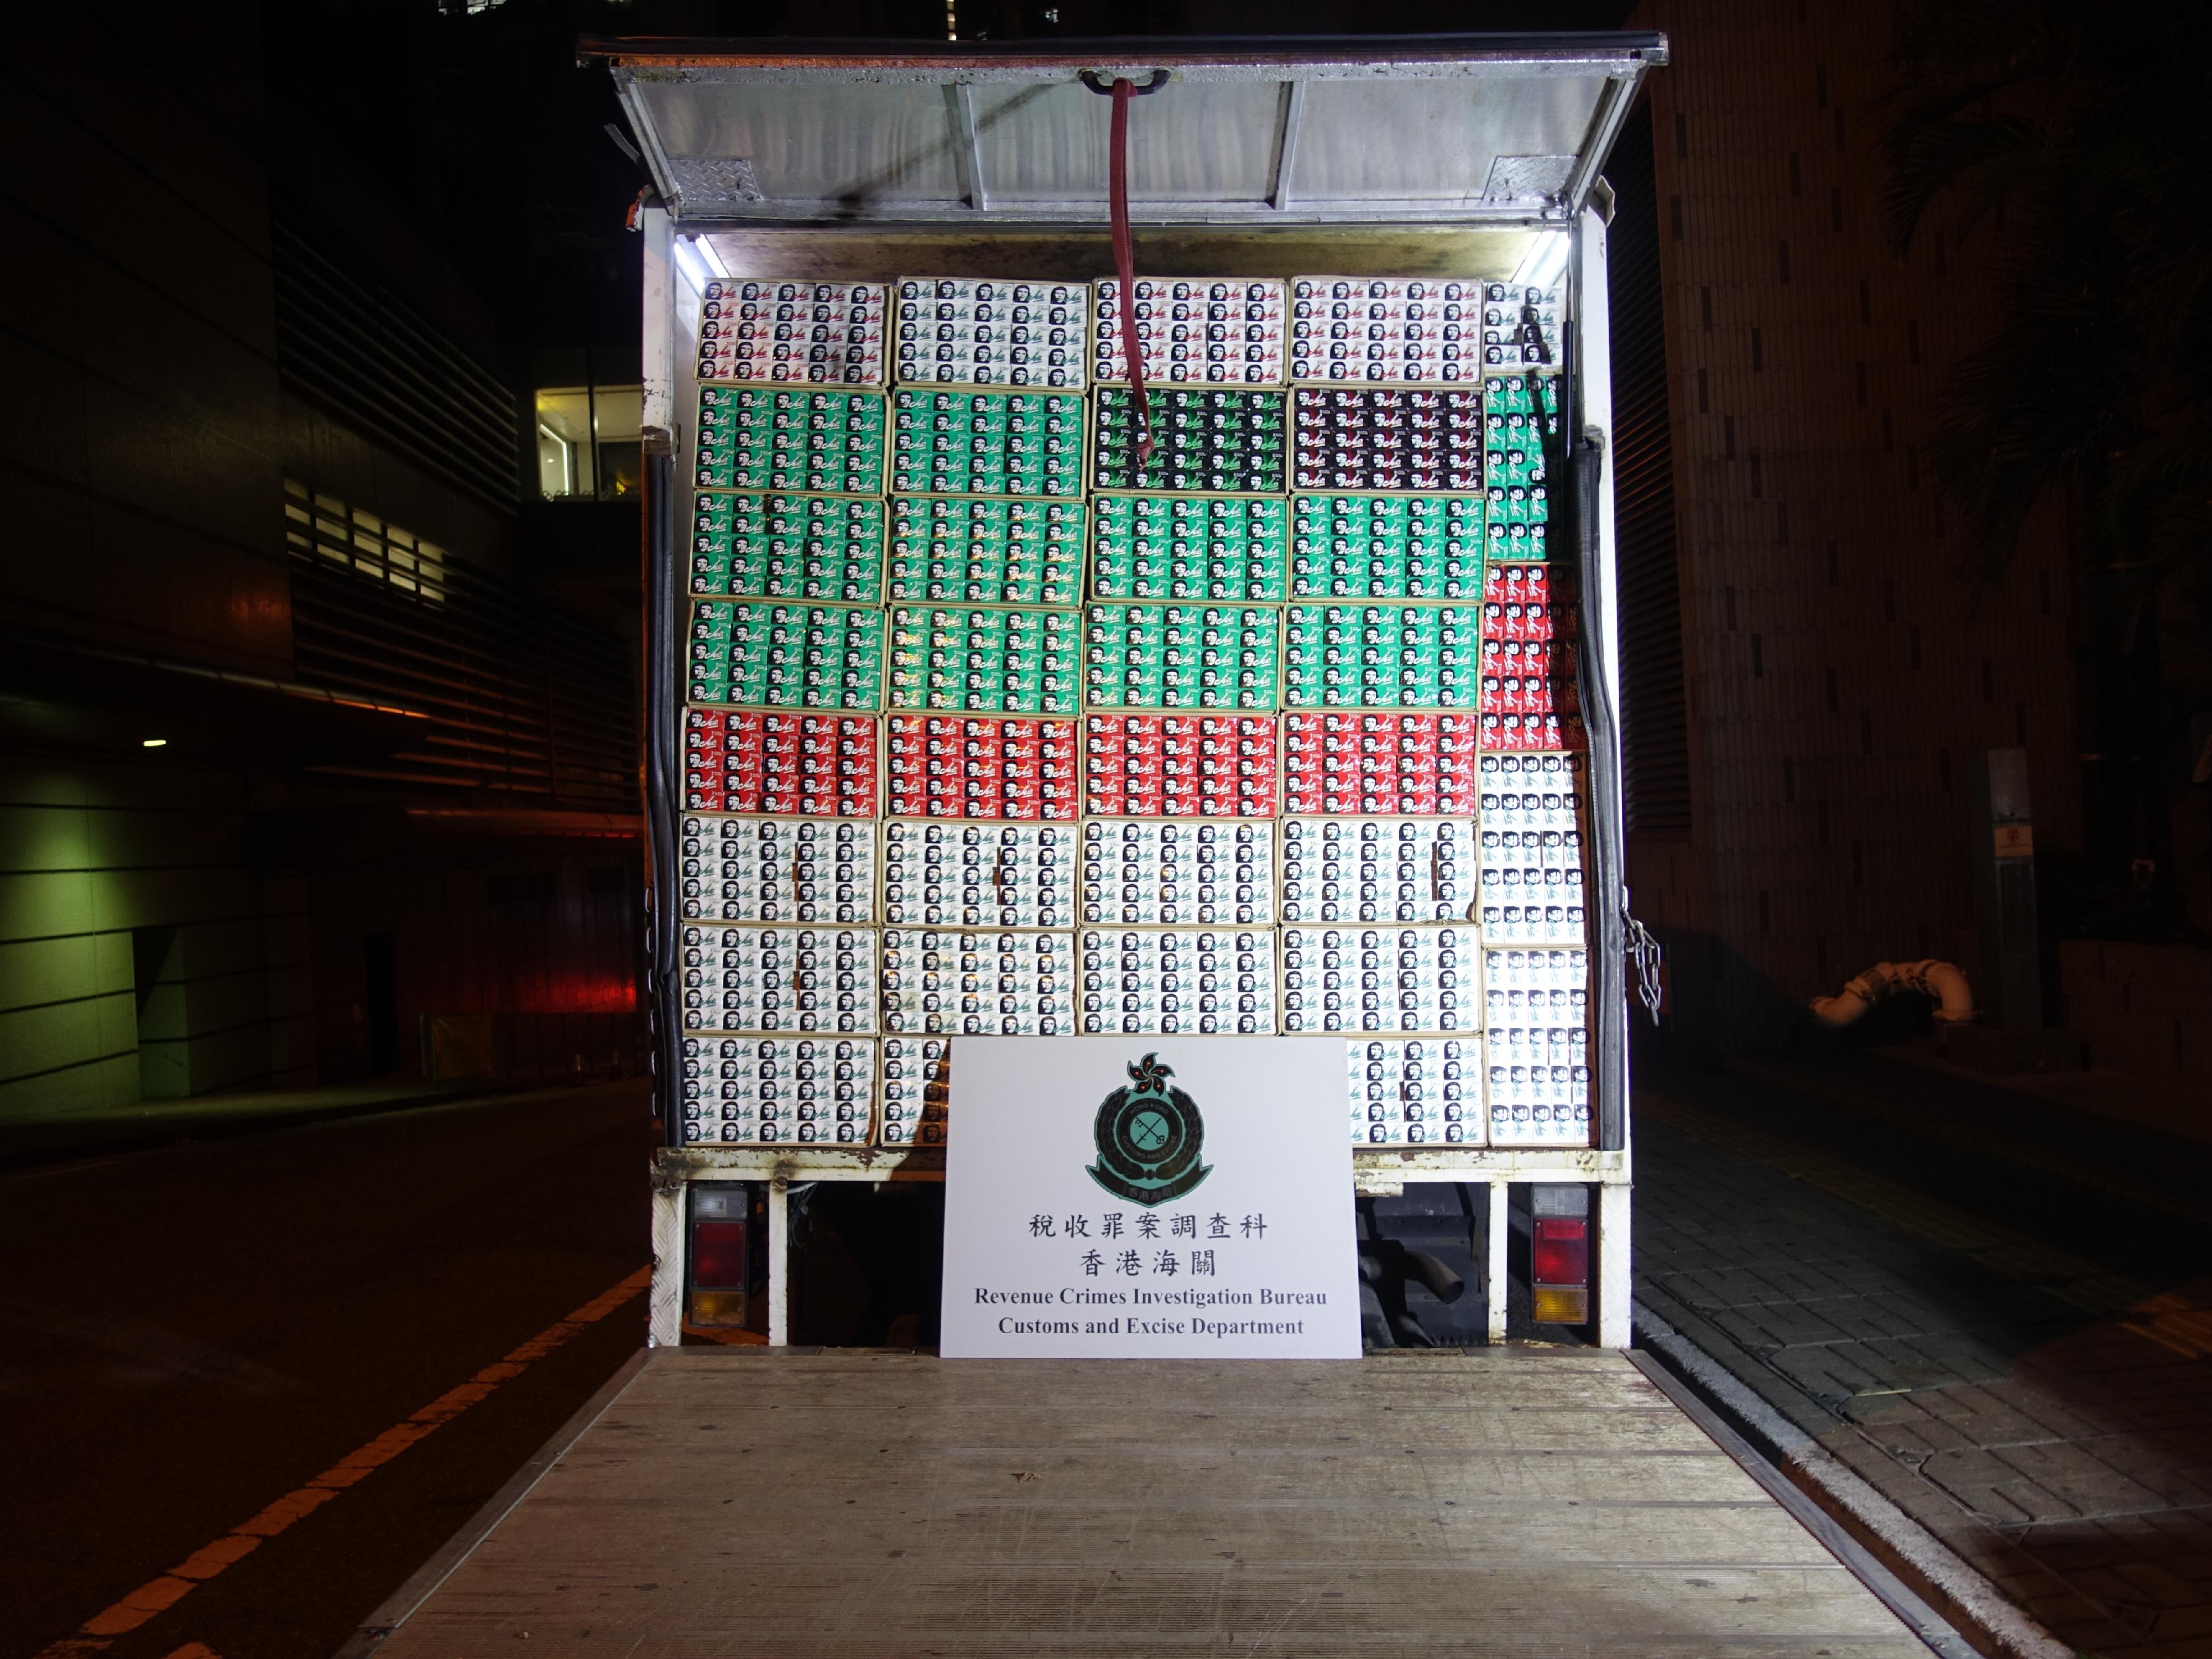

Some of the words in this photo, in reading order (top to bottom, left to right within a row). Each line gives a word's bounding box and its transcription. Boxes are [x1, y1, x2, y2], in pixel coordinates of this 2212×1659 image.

[1307, 393, 1326, 406] che
[1383, 414, 1402, 427] che
[1344, 454, 1364, 467] che
[1420, 475, 1439, 488] che
[738, 717, 757, 730] che
[1099, 719, 1118, 733] che
[1250, 722, 1270, 735] che
[813, 740, 832, 754] che
[1052, 745, 1071, 758] che
[1335, 738, 1354, 752] che
[776, 759, 795, 773] che
[938, 761, 958, 775] che
[977, 784, 996, 796] che
[1099, 780, 1118, 793] che
[1213, 781, 1232, 794] che
[774, 798, 793, 811] che
[902, 800, 921, 813] che
[1373, 799, 1392, 812] che
[1029, 1212, 1267, 1240] 稅收罪案調查科
[1080, 1248, 1215, 1277] 香港海關
[974, 1287, 1053, 1304] Revenue
[1060, 1287, 1126, 1304] Crimes
[1133, 1288, 1253, 1309] Investigation
[1259, 1288, 1327, 1305] Bureau
[998, 1317, 1079, 1334] Customs
[1086, 1317, 1120, 1334] and
[1126, 1317, 1185, 1334] Excise
[1191, 1317, 1304, 1338] Department
